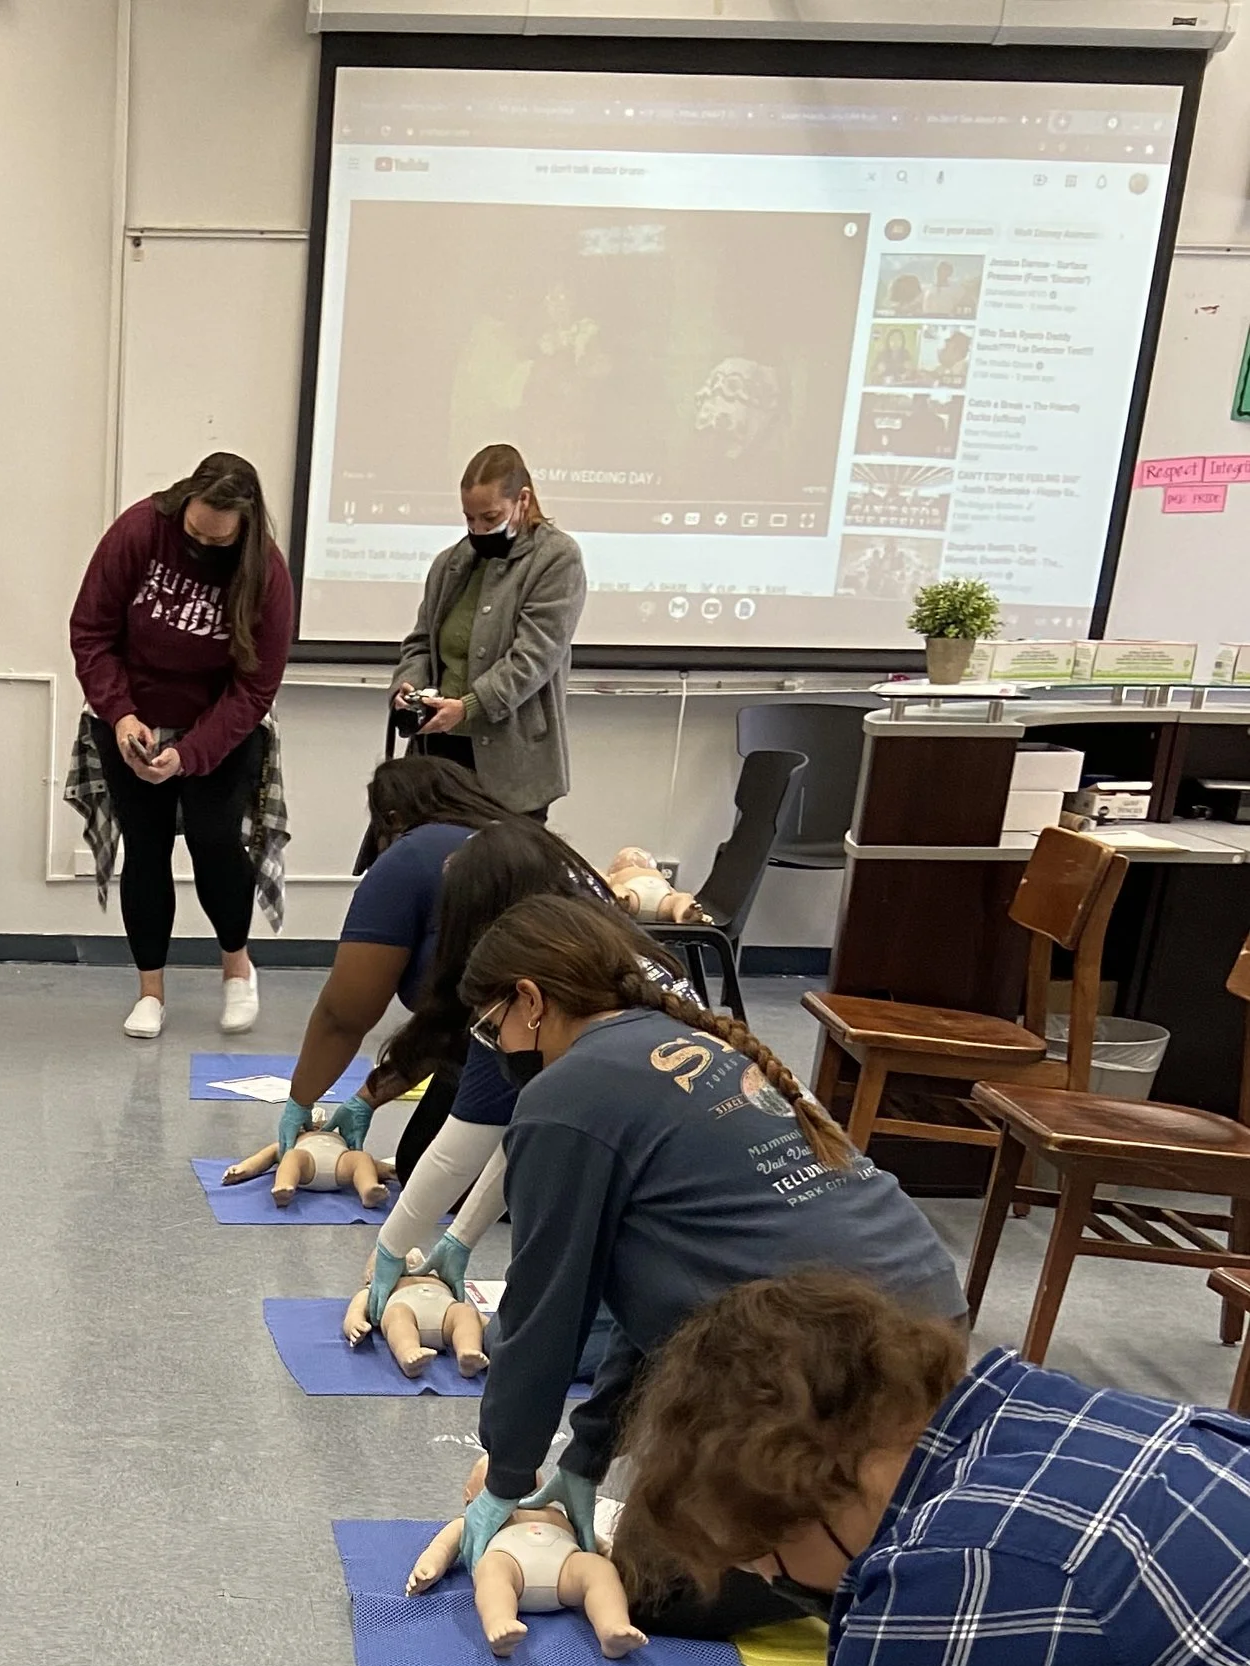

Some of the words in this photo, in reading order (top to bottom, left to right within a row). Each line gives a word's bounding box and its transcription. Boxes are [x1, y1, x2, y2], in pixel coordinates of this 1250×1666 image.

[530, 468, 547, 480] AS
[548, 468, 568, 482] MY
[570, 470, 627, 485] WEDDING
[629, 471, 654, 485] DAY
[1146, 463, 1197, 482] Respect
[706, 1058, 739, 1089] TOURS
[786, 1185, 825, 1208] PARK
[825, 1176, 849, 1192] CITY
